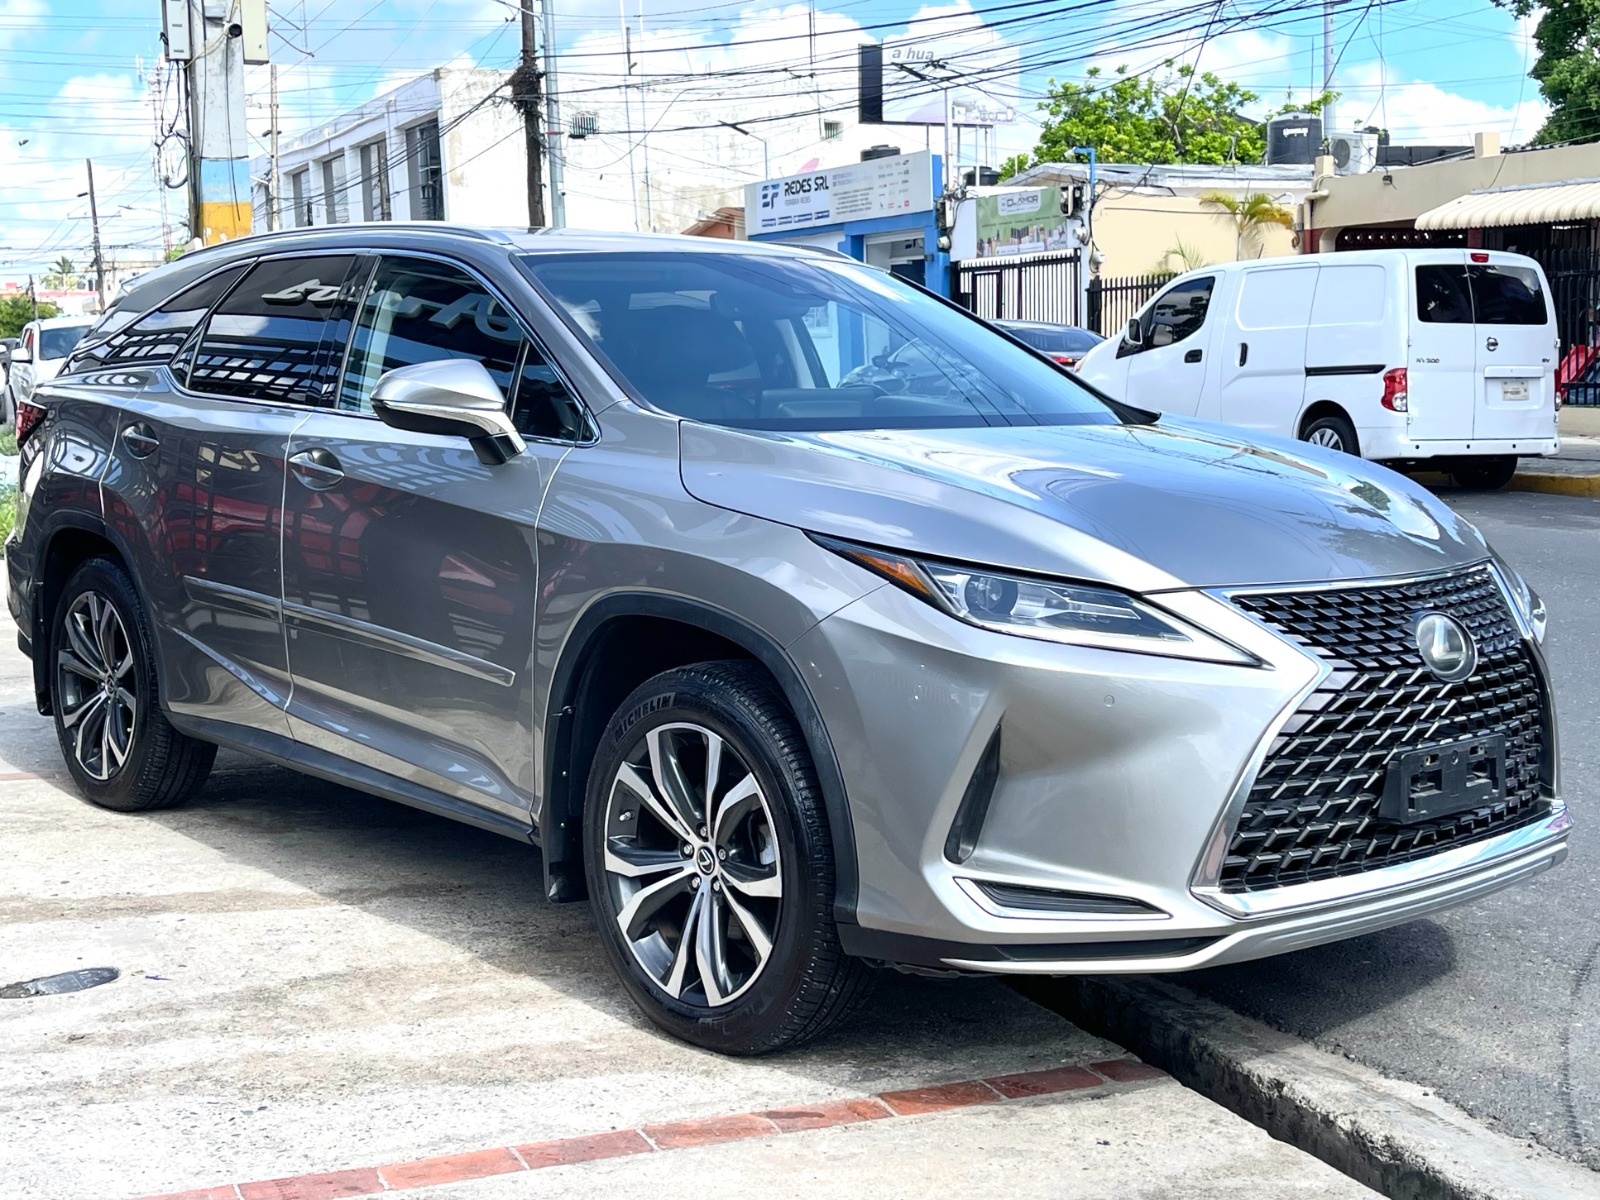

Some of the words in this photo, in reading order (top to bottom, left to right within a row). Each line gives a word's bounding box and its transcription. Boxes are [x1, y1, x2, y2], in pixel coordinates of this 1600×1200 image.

[784, 178, 812, 197] REDES
[814, 175, 830, 191] SRL
[614, 694, 673, 743] MICHELIN
